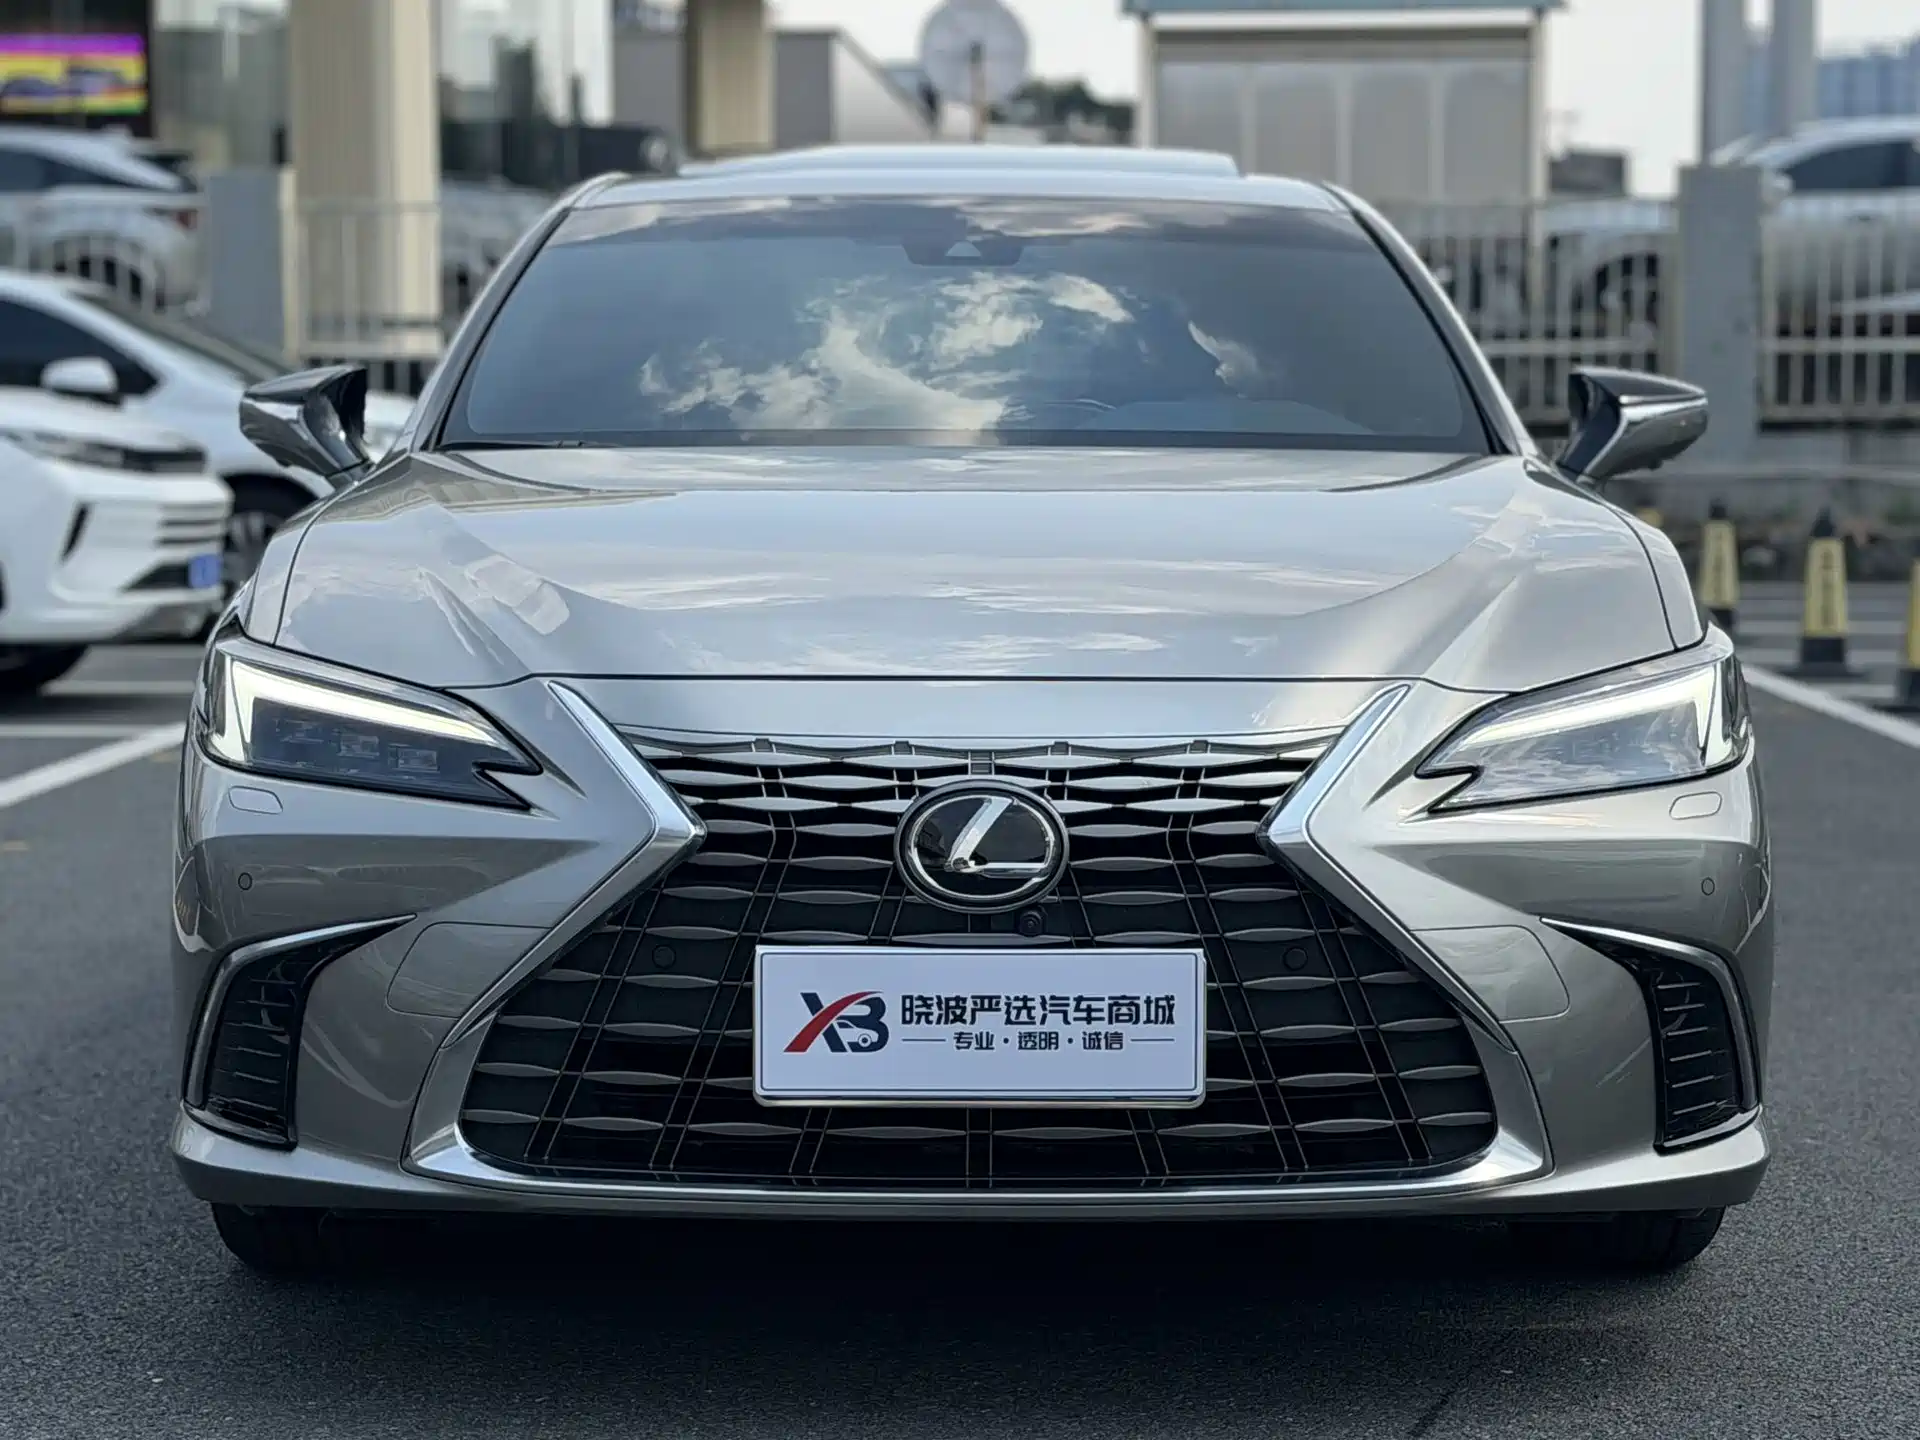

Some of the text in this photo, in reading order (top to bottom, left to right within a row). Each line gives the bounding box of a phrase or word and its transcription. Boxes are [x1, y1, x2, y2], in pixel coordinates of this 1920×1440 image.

[900, 994, 1176, 1026] 晓波严选汽车商城
